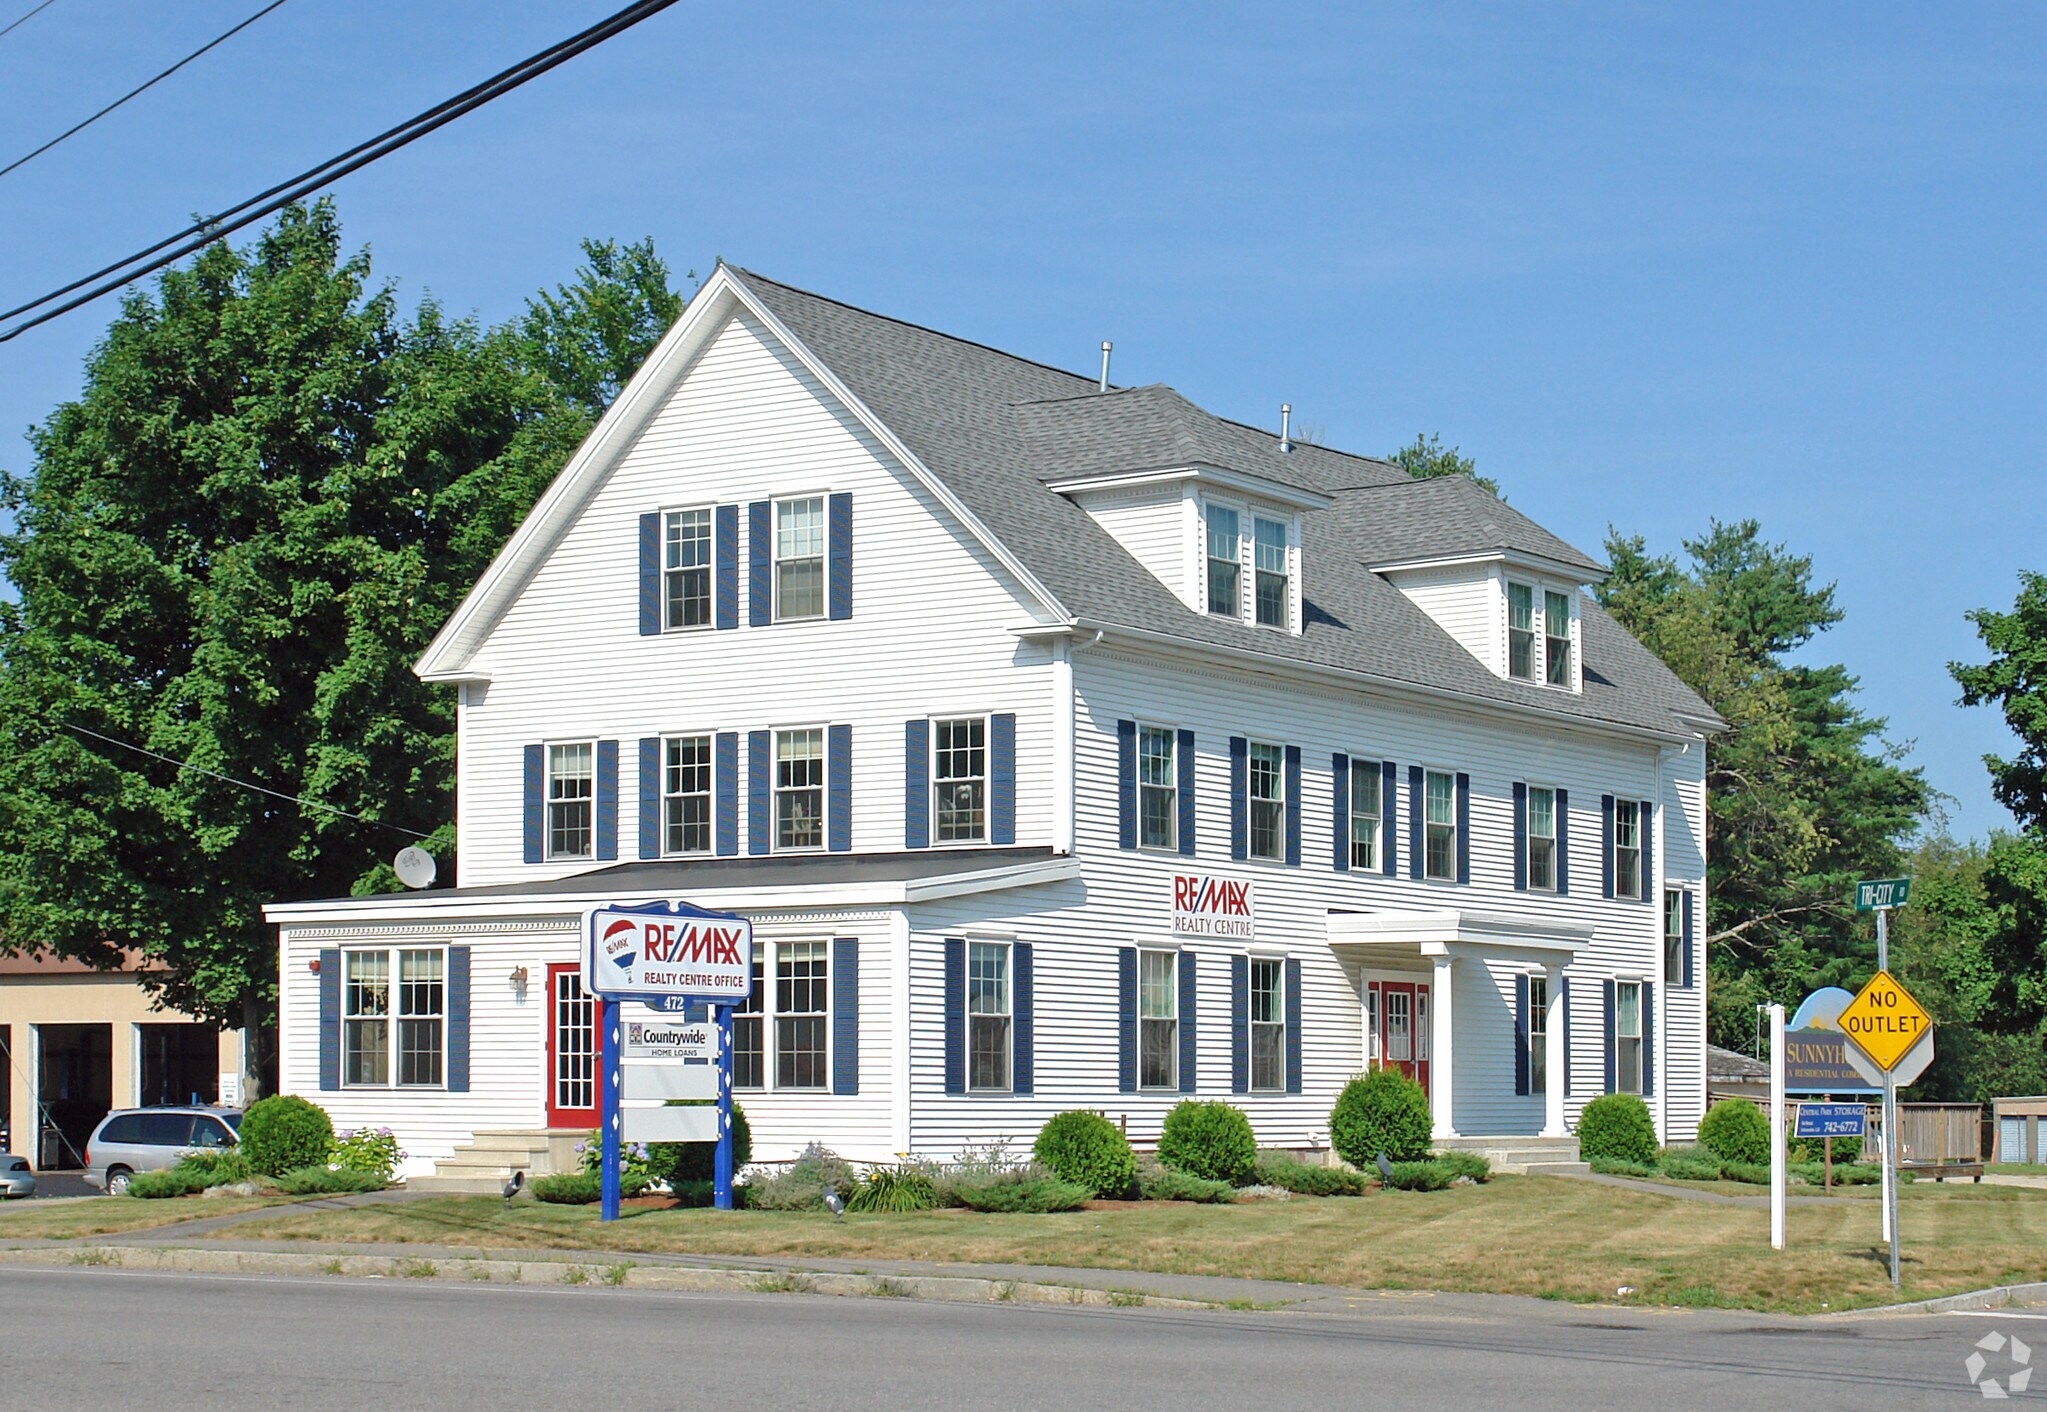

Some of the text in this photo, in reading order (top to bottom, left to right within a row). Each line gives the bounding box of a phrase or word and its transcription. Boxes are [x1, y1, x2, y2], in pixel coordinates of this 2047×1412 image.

[1175, 876, 1251, 917] RE/MAX
[1861, 884, 1895, 906] TRI-CITY
[1175, 917, 1251, 936] REALTY CENTRE
[645, 922, 743, 965] RE/MAX
[645, 972, 744, 988] REALTY CENTRE OFFICE
[664, 997, 684, 1010] 472
[1869, 991, 1897, 1008] NO
[1849, 1016, 1920, 1033] OUTLET
[643, 1029, 706, 1046] Countrywide
[1795, 1069, 1839, 1078] RESIDENTIAL
[1834, 1107, 1864, 1116] STORAGE
[1824, 1121, 1857, 1133] 742-6772
